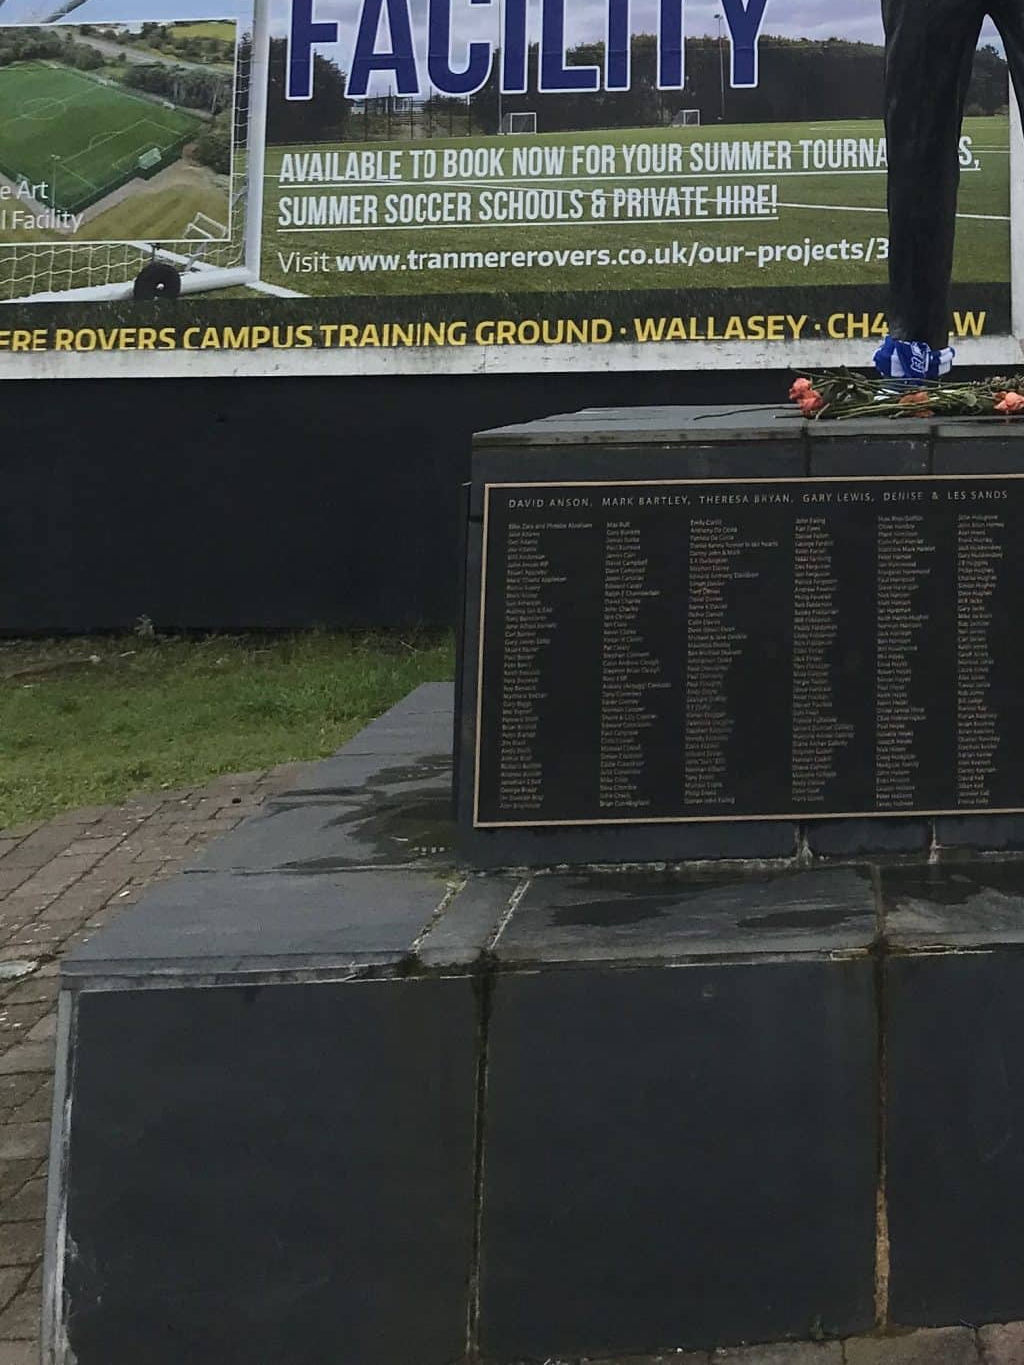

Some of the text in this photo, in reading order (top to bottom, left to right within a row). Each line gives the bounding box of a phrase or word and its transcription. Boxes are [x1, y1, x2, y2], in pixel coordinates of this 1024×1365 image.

[279, 150, 402, 182] AVAILABLE
[409, 149, 437, 179] TO
[442, 147, 505, 178] BOOK
[512, 145, 565, 176] NOW
[572, 144, 616, 175] FOR
[623, 142, 682, 174] YOUR
[690, 140, 792, 172] SUMMER
[16, 180, 49, 200] Art
[278, 184, 778, 226] SUMMER SOCCER SCHOOLS & PRIVATE HIRE!
[12, 208, 84, 233] Facility
[277, 251, 331, 273] Visit
[55, 327, 176, 351] ROVERS
[183, 325, 312, 350] CAMPUS
[319, 321, 467, 347] TRAINING
[475, 318, 612, 346] GROUND
[634, 314, 808, 343] WALLASEY
[508, 498, 544, 509] DAVID
[602, 496, 634, 507] MARK
[699, 494, 749, 505] THERESA
[802, 493, 833, 503] GARY
[883, 491, 923, 501] DENISE
[931, 491, 939, 500] &
[947, 490, 967, 500] LES
[971, 490, 1008, 499] SANDS
